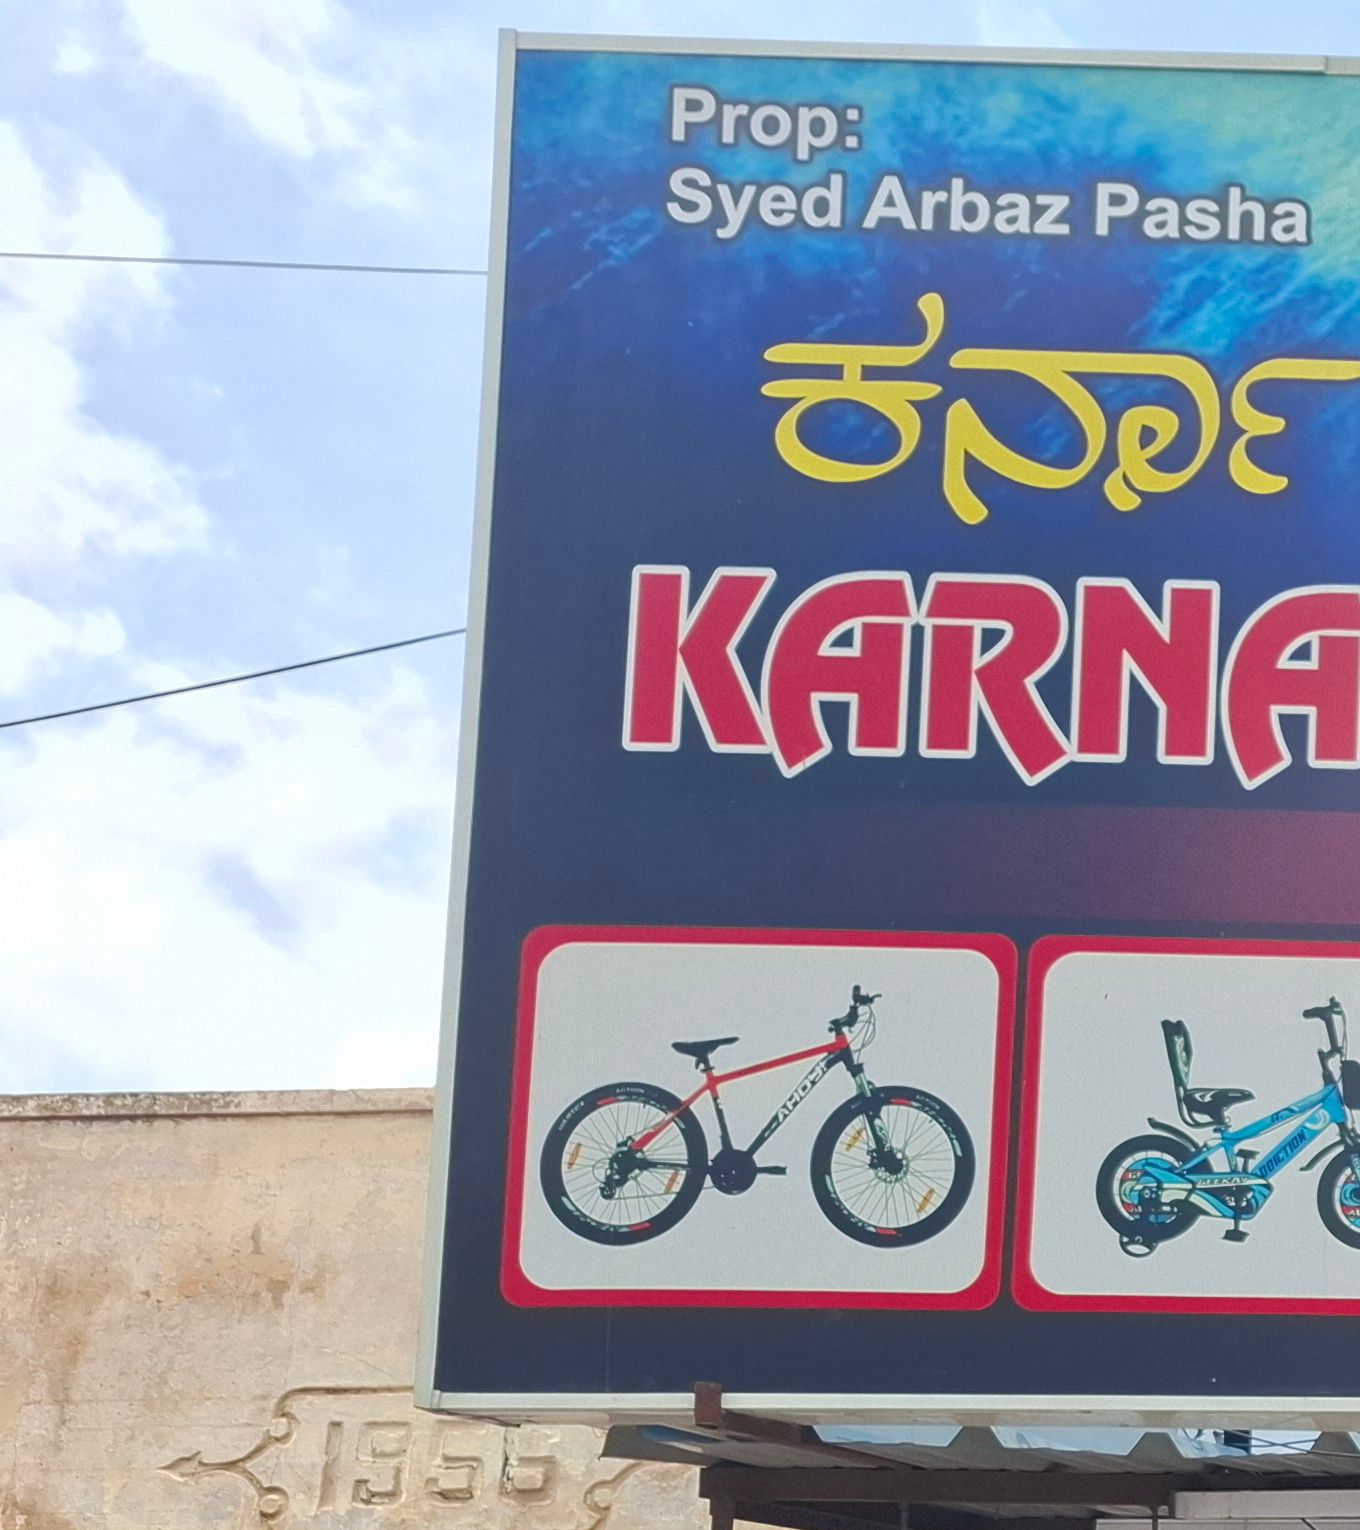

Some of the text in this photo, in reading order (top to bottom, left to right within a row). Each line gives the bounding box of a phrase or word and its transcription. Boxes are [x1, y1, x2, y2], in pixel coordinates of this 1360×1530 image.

[671, 87, 860, 152] Prop:
[667, 167, 1310, 244] Syed Arbaz Pasha
[1256, 1129, 1308, 1178] DDICTION
[311, 1419, 560, 1518] 1956
